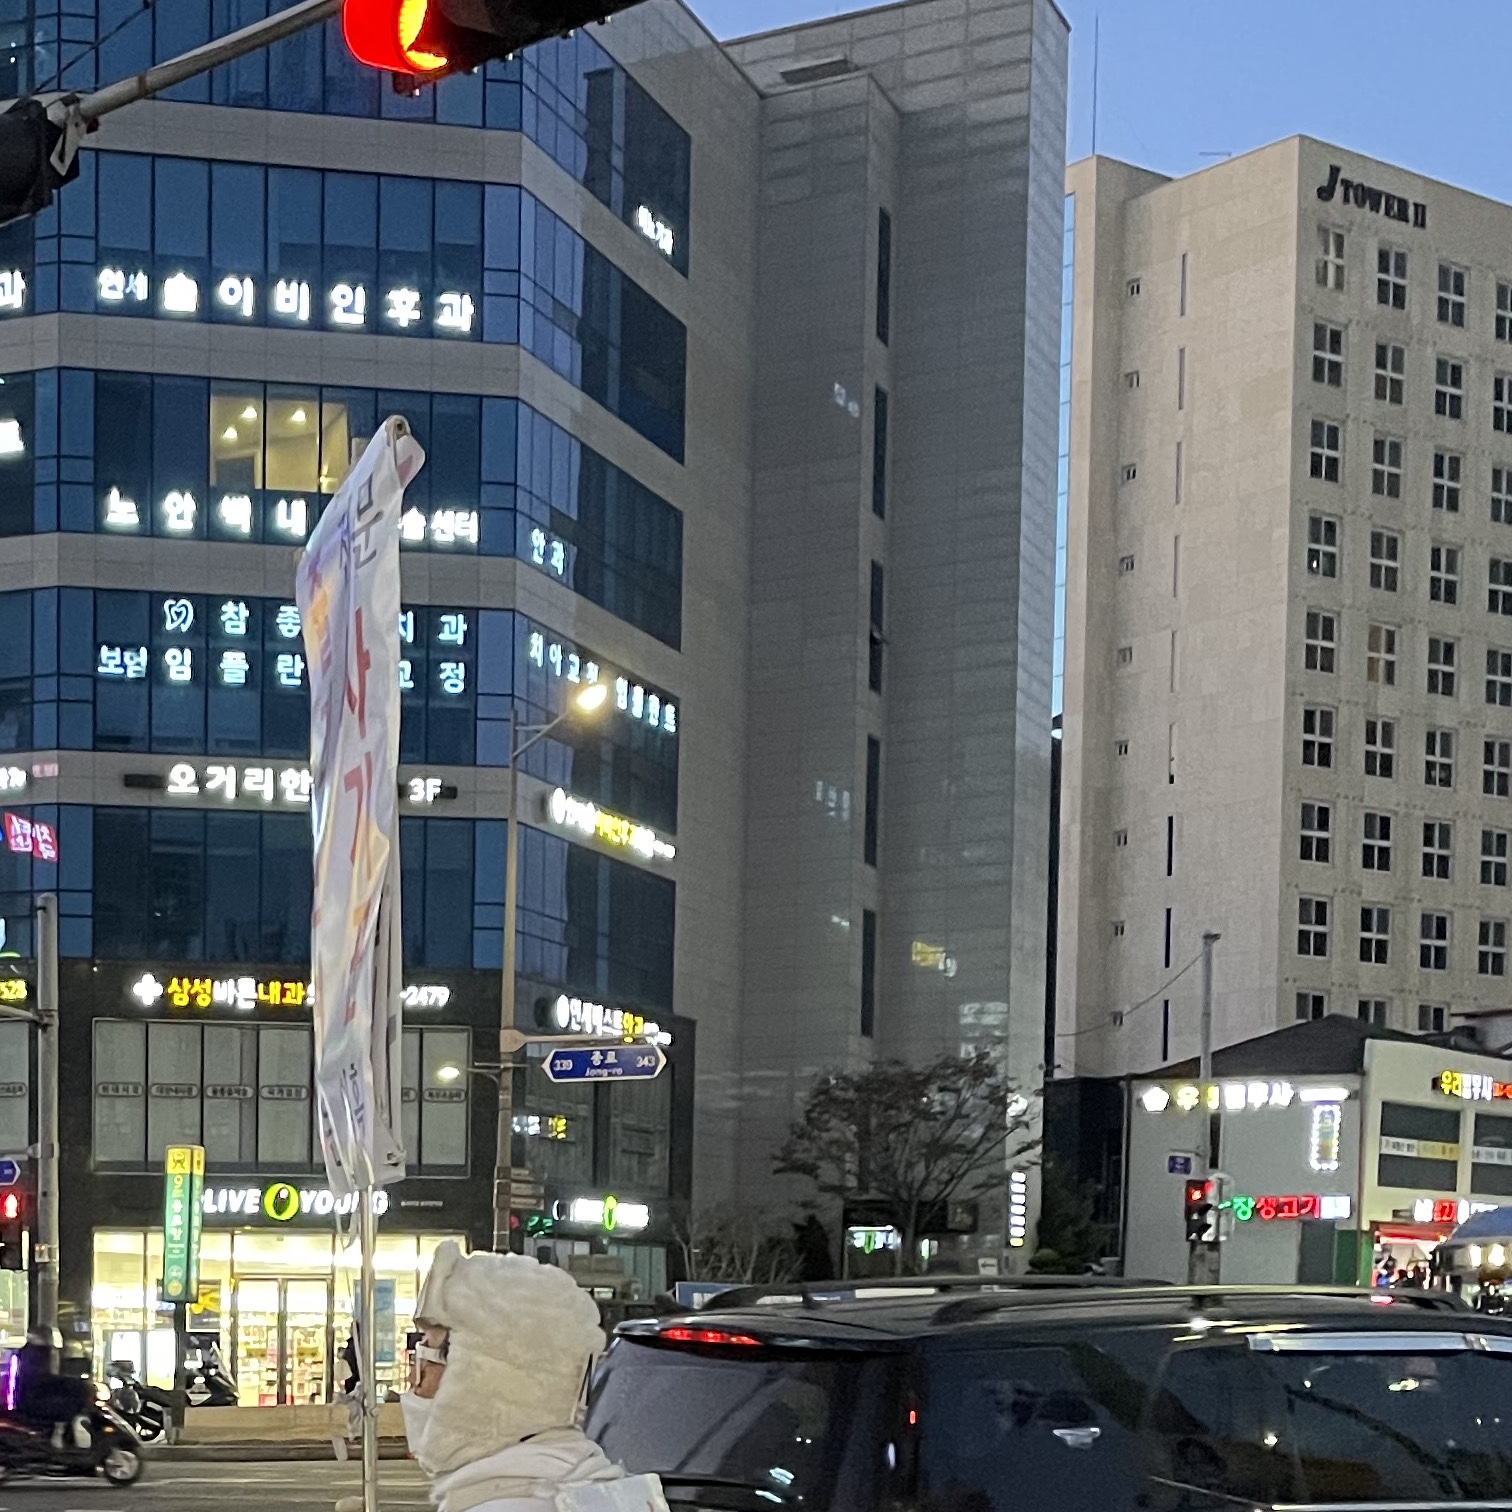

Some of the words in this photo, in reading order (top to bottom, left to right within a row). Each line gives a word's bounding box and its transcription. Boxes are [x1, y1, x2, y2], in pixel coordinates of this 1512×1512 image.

[167, 762, 314, 802] 오거리한
[408, 777, 443, 804] 3F
[167, 976, 315, 1009] 삼성바른내과
[202, 1188, 262, 1214] LIVE
